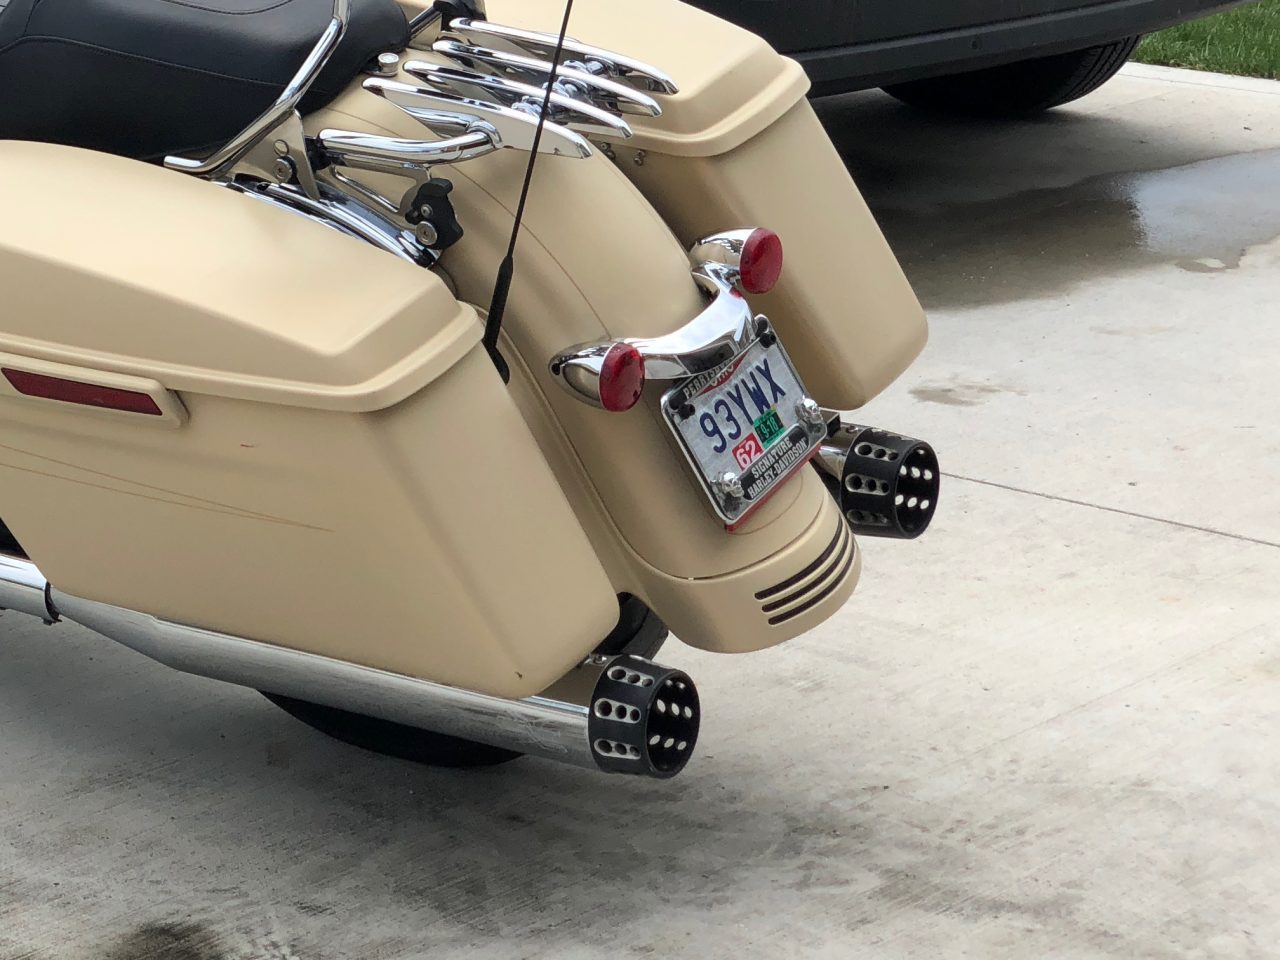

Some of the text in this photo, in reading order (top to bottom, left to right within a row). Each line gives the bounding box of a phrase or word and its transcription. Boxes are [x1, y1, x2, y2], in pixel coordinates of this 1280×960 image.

[699, 357, 786, 454] 93YWX
[736, 440, 761, 469] 62
[747, 439, 808, 499] HARLEY-DAVIDSON
[751, 436, 793, 479] SIGNATURE
